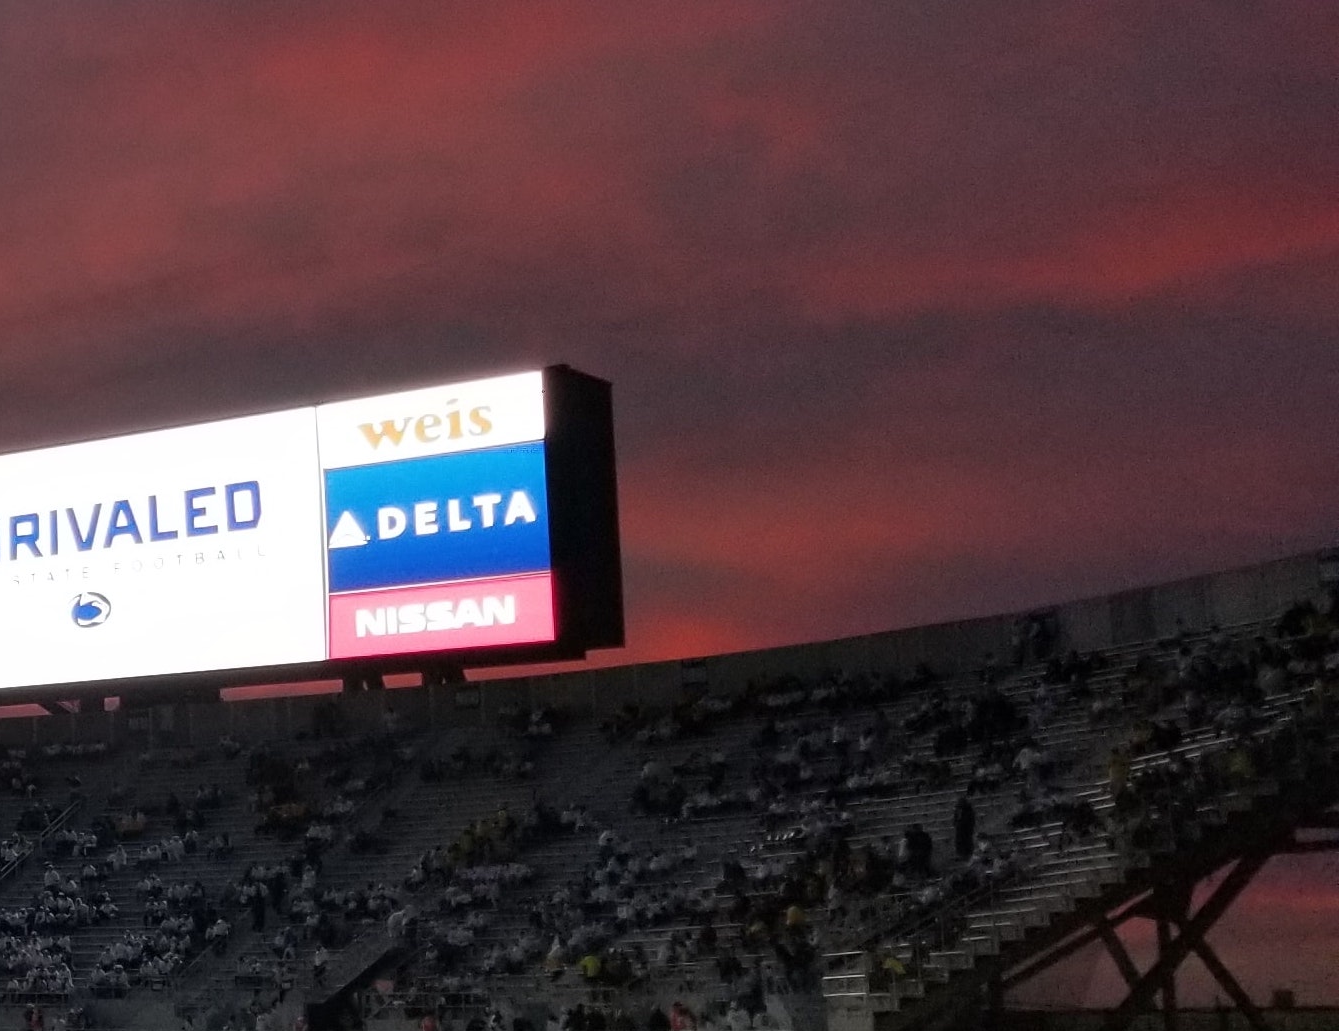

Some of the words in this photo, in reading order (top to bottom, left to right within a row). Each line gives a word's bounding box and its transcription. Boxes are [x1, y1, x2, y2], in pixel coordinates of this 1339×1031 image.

[358, 399, 493, 450] weis
[377, 490, 537, 540] DELTA
[12, 567, 90, 585] STATE
[114, 545, 266, 574] FOOTBALL
[355, 595, 516, 638] NISSAN
